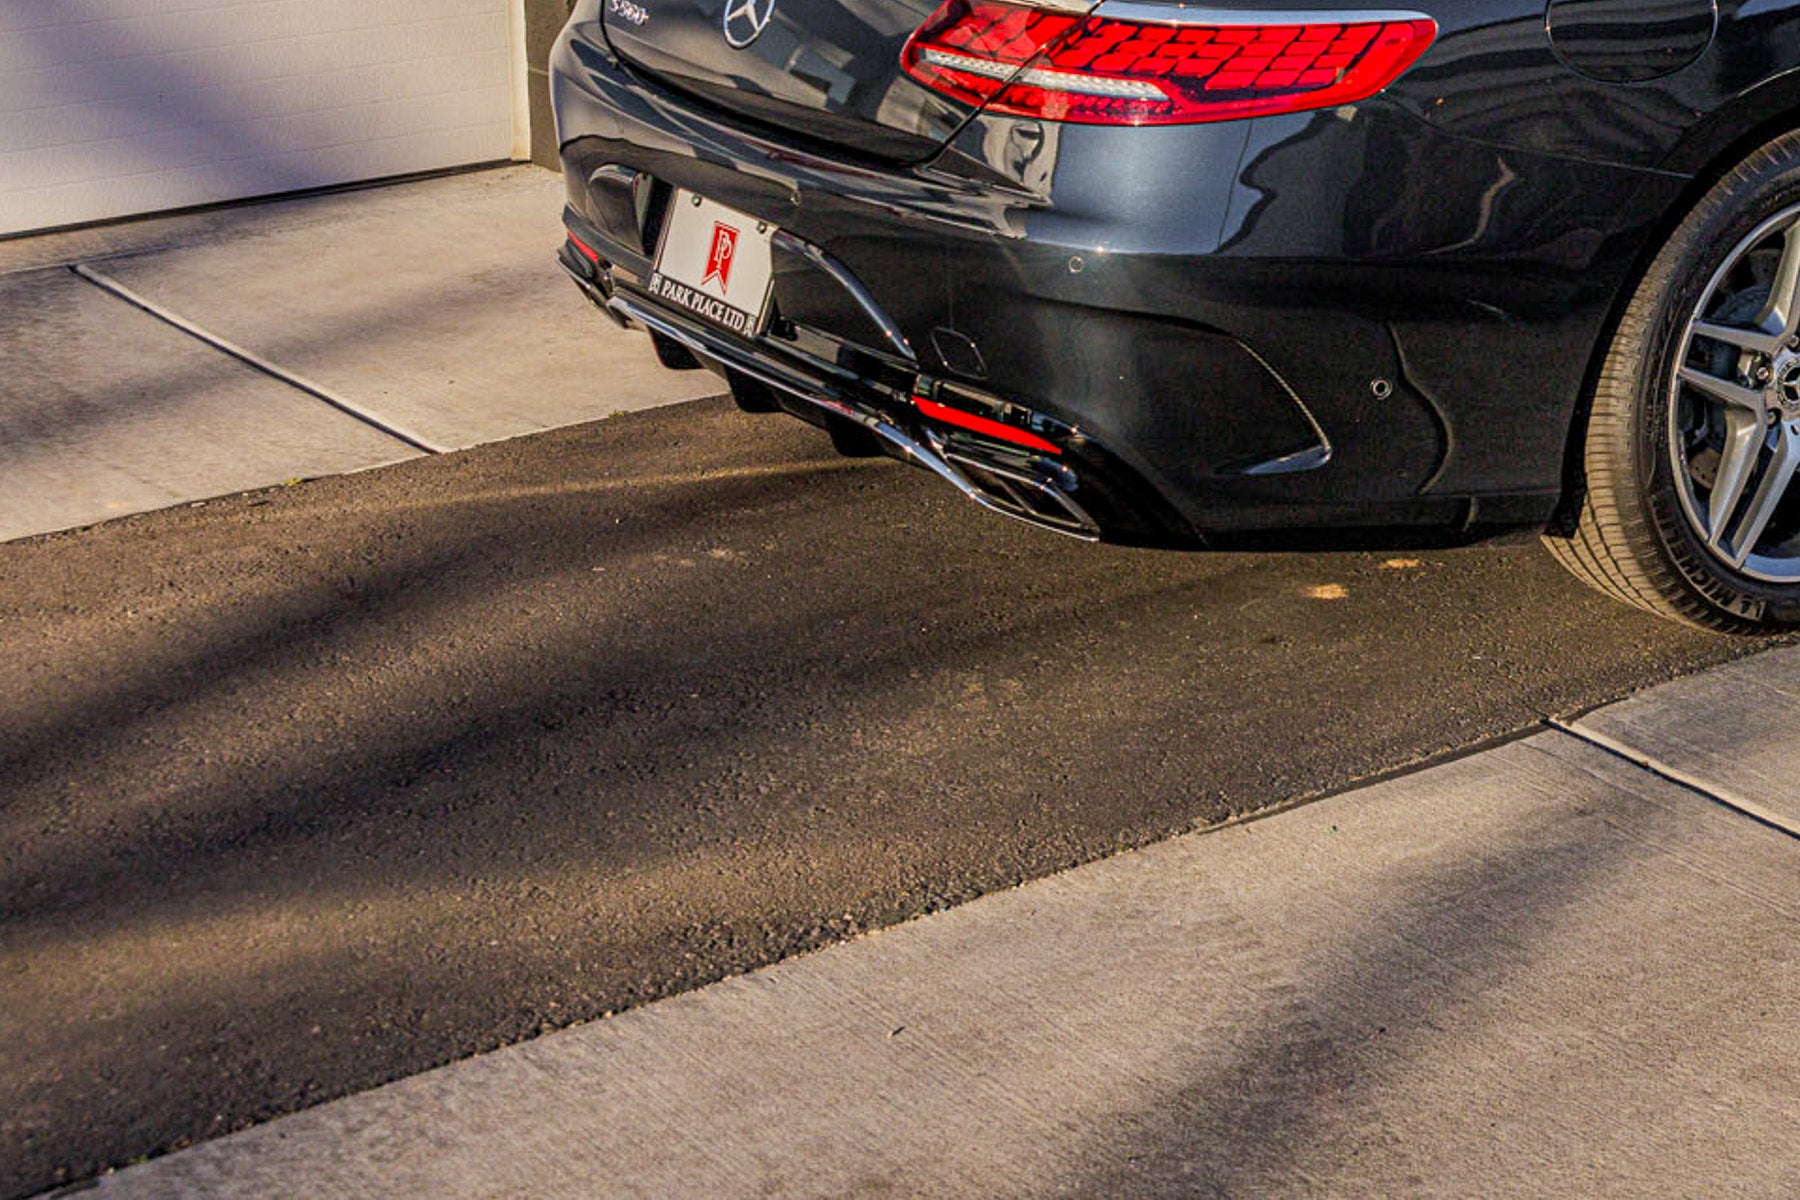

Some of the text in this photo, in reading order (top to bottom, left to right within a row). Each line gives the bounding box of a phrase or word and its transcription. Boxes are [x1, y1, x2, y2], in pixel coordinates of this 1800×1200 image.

[660, 279, 745, 331] PARK PLACE LTD
